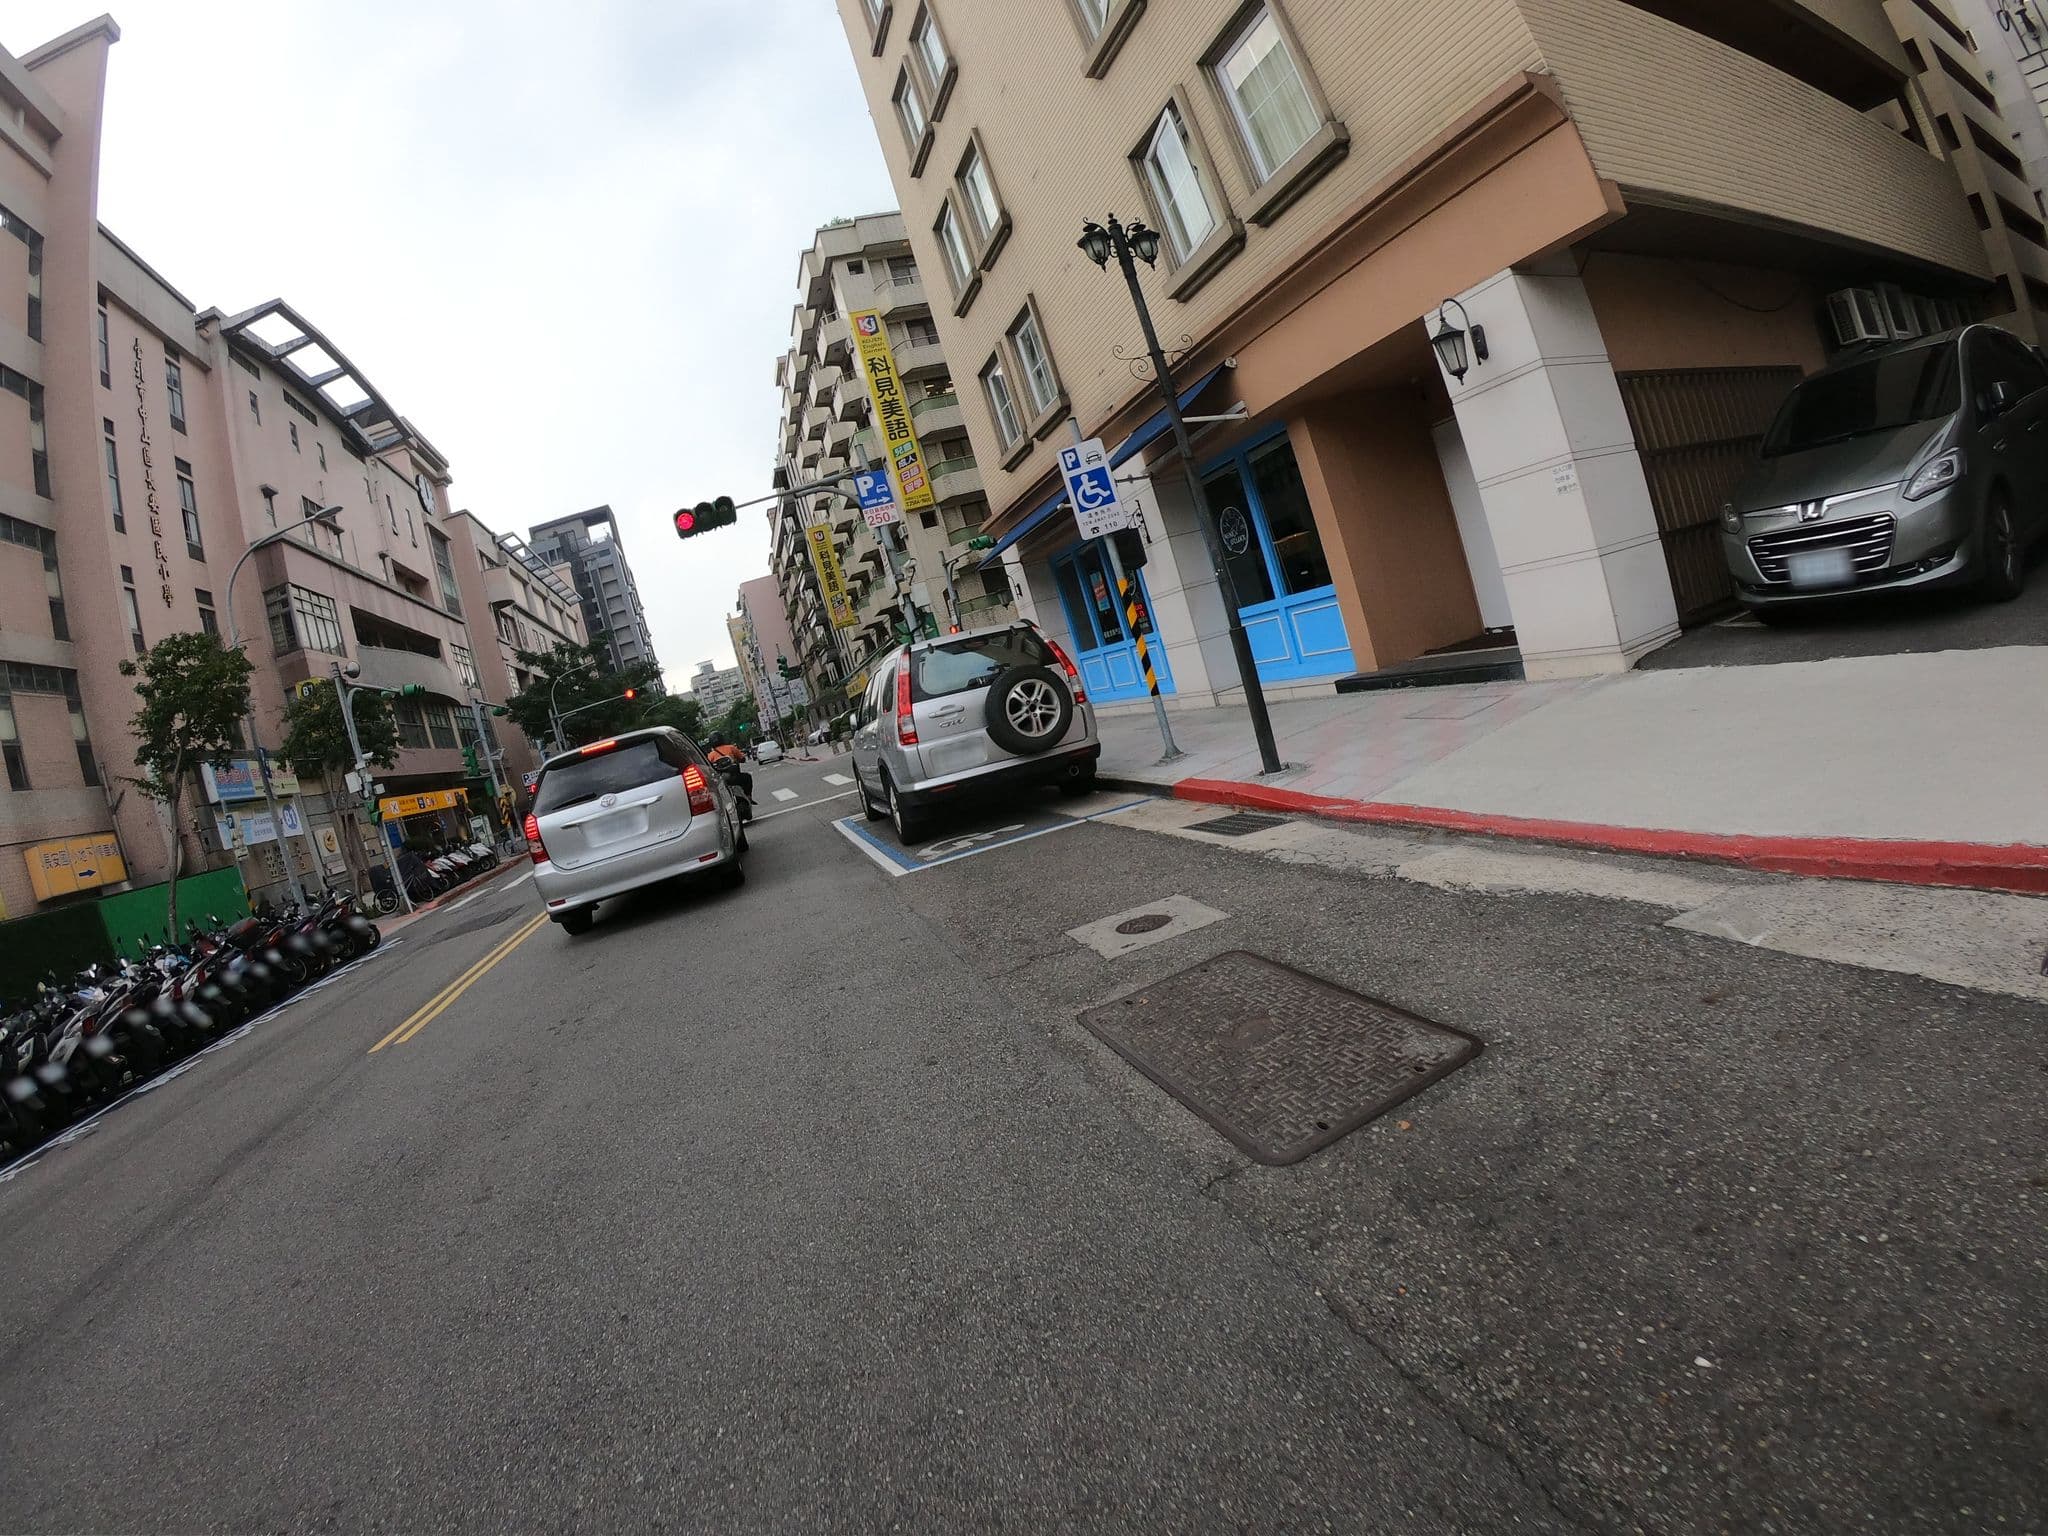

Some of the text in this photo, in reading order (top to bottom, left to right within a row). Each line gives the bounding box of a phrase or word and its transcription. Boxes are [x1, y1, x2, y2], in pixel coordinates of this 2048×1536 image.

[867, 355, 909, 440] 科見美語
[1064, 452, 1076, 468] P
[856, 476, 874, 497] P
[1104, 521, 1118, 530] 110
